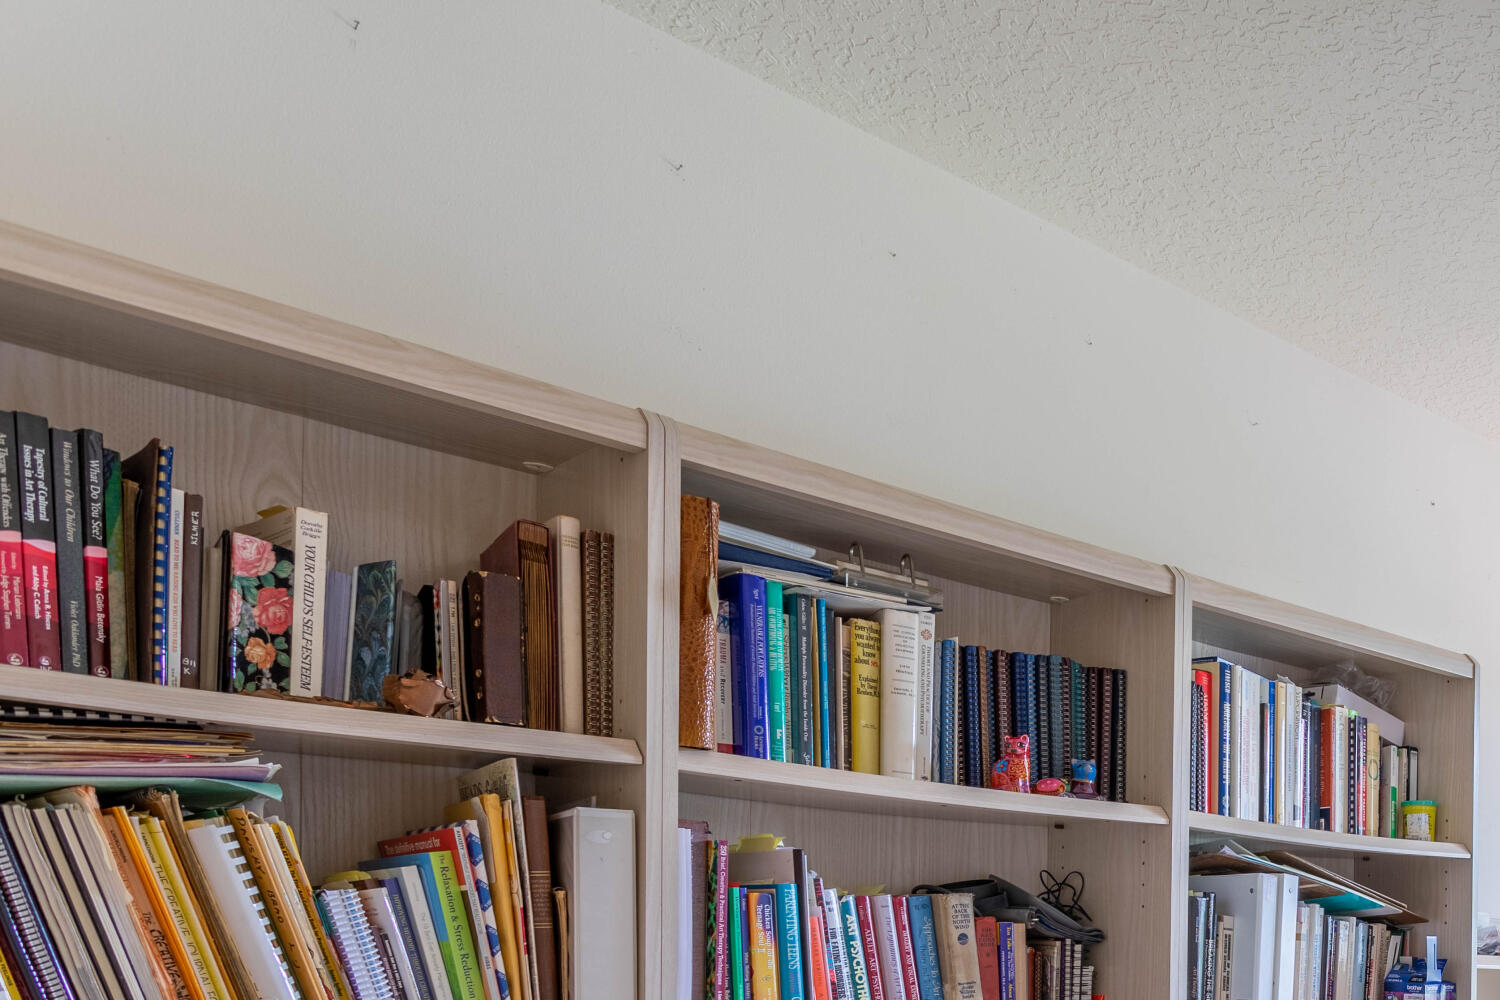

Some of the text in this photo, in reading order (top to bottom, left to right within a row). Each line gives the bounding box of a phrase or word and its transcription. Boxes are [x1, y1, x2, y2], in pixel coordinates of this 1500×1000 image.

[25, 478, 34, 491] Art
[23, 493, 36, 524] Therapy
[89, 460, 103, 541] What Do You See?
[305, 545, 316, 574] YOUR
[439, 864, 456, 914] Relaxation
[451, 915, 461, 927] &
[846, 914, 856, 936] ART
[453, 925, 466, 949] Stress
[460, 953, 476, 1000] Reduction
